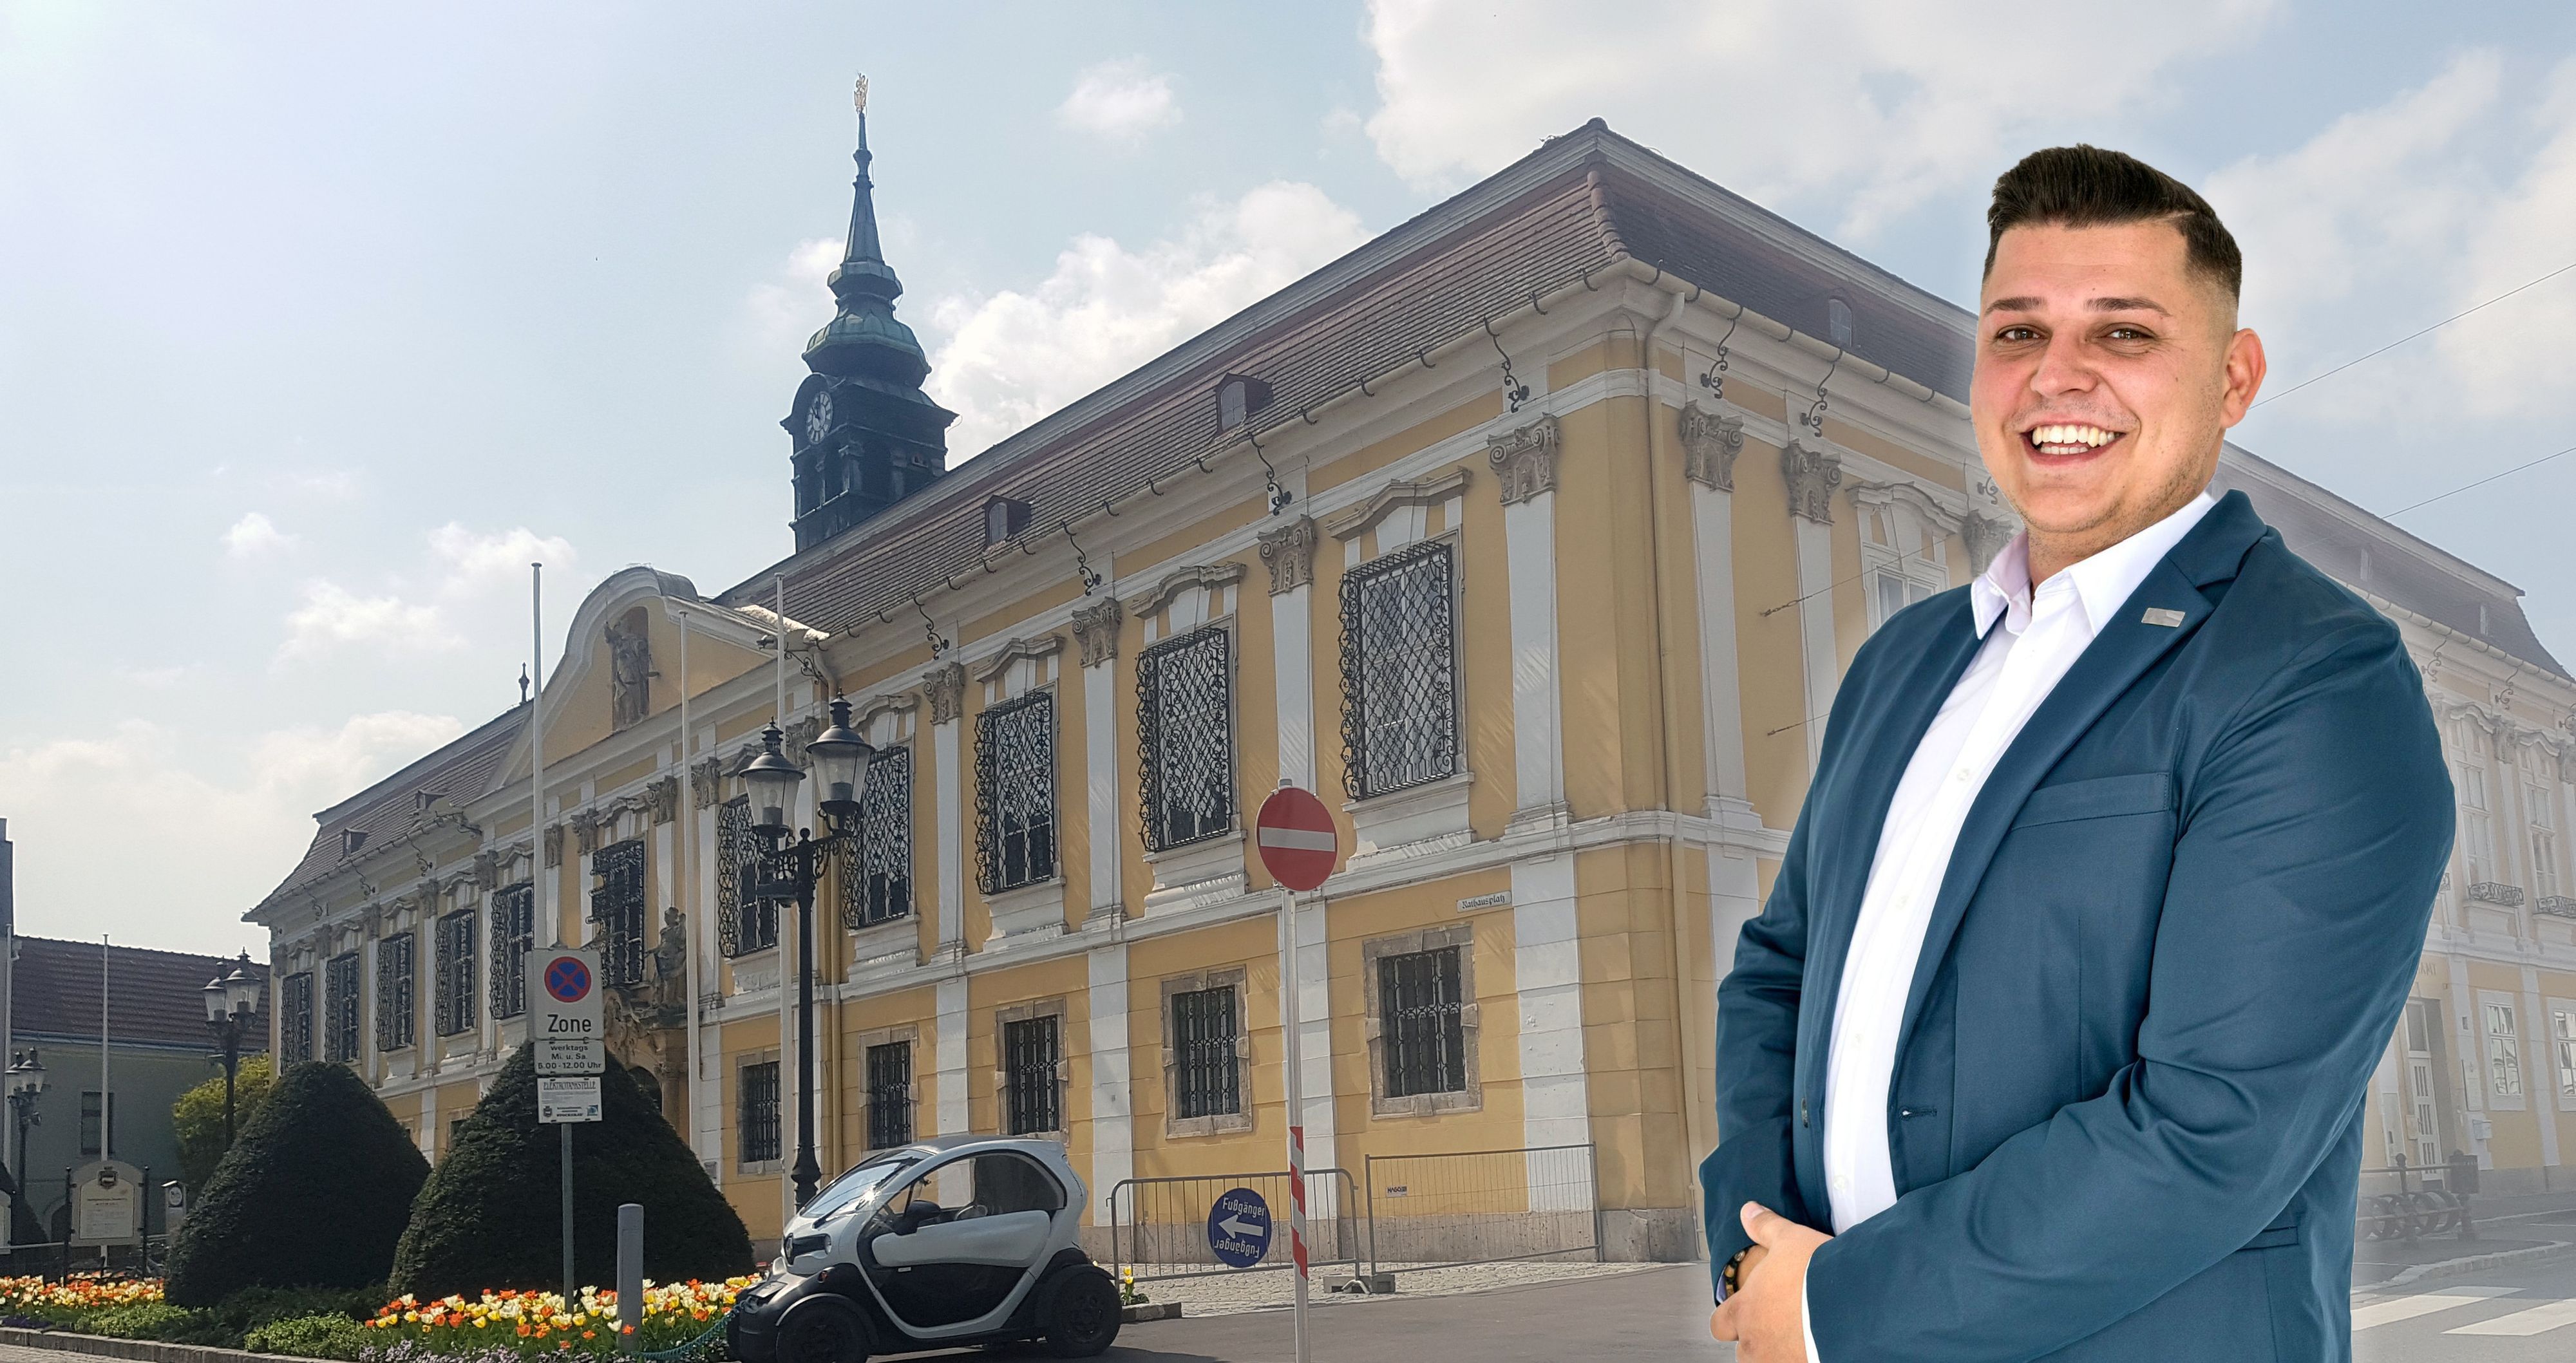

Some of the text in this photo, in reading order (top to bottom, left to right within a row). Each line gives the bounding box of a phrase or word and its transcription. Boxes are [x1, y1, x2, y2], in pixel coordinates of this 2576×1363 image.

[1462, 895, 1505, 908] Rathausplatz
[547, 1014, 591, 1033] Zone
[1222, 1197, 1265, 1218] Fußgänger
[1214, 1237, 1260, 1259] Fußgänger
